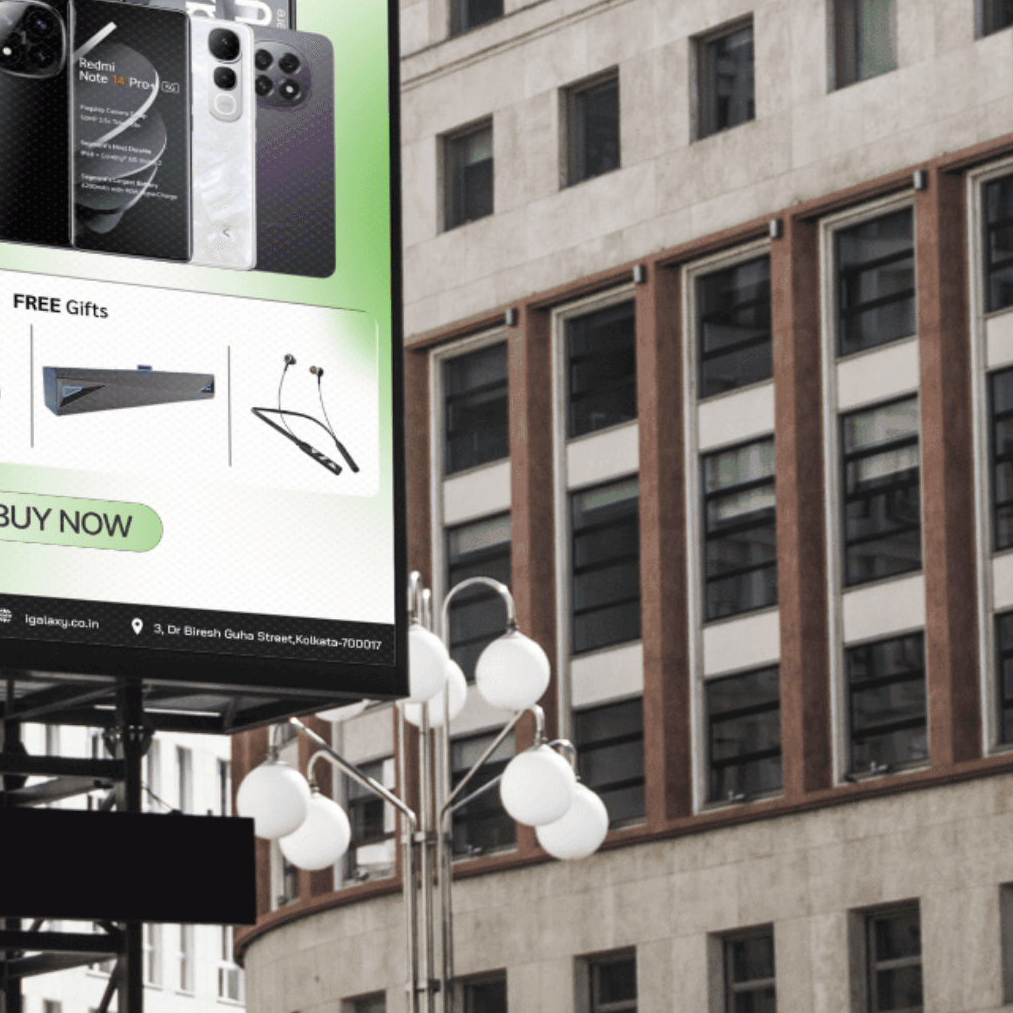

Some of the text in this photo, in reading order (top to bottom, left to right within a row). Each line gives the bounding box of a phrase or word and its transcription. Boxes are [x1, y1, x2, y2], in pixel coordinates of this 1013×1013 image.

[79, 57, 115, 72] Redmi
[79, 70, 108, 83] Note
[112, 74, 125, 86] 14
[13, 293, 109, 319] FREE Gifts
[59, 509, 133, 538] NOW
[25, 613, 99, 629] igalaxy.co.in
[153, 623, 164, 635] 3,
[167, 624, 181, 635] Dr
[183, 625, 221, 639] Biresh
[224, 628, 254, 641] Guha
